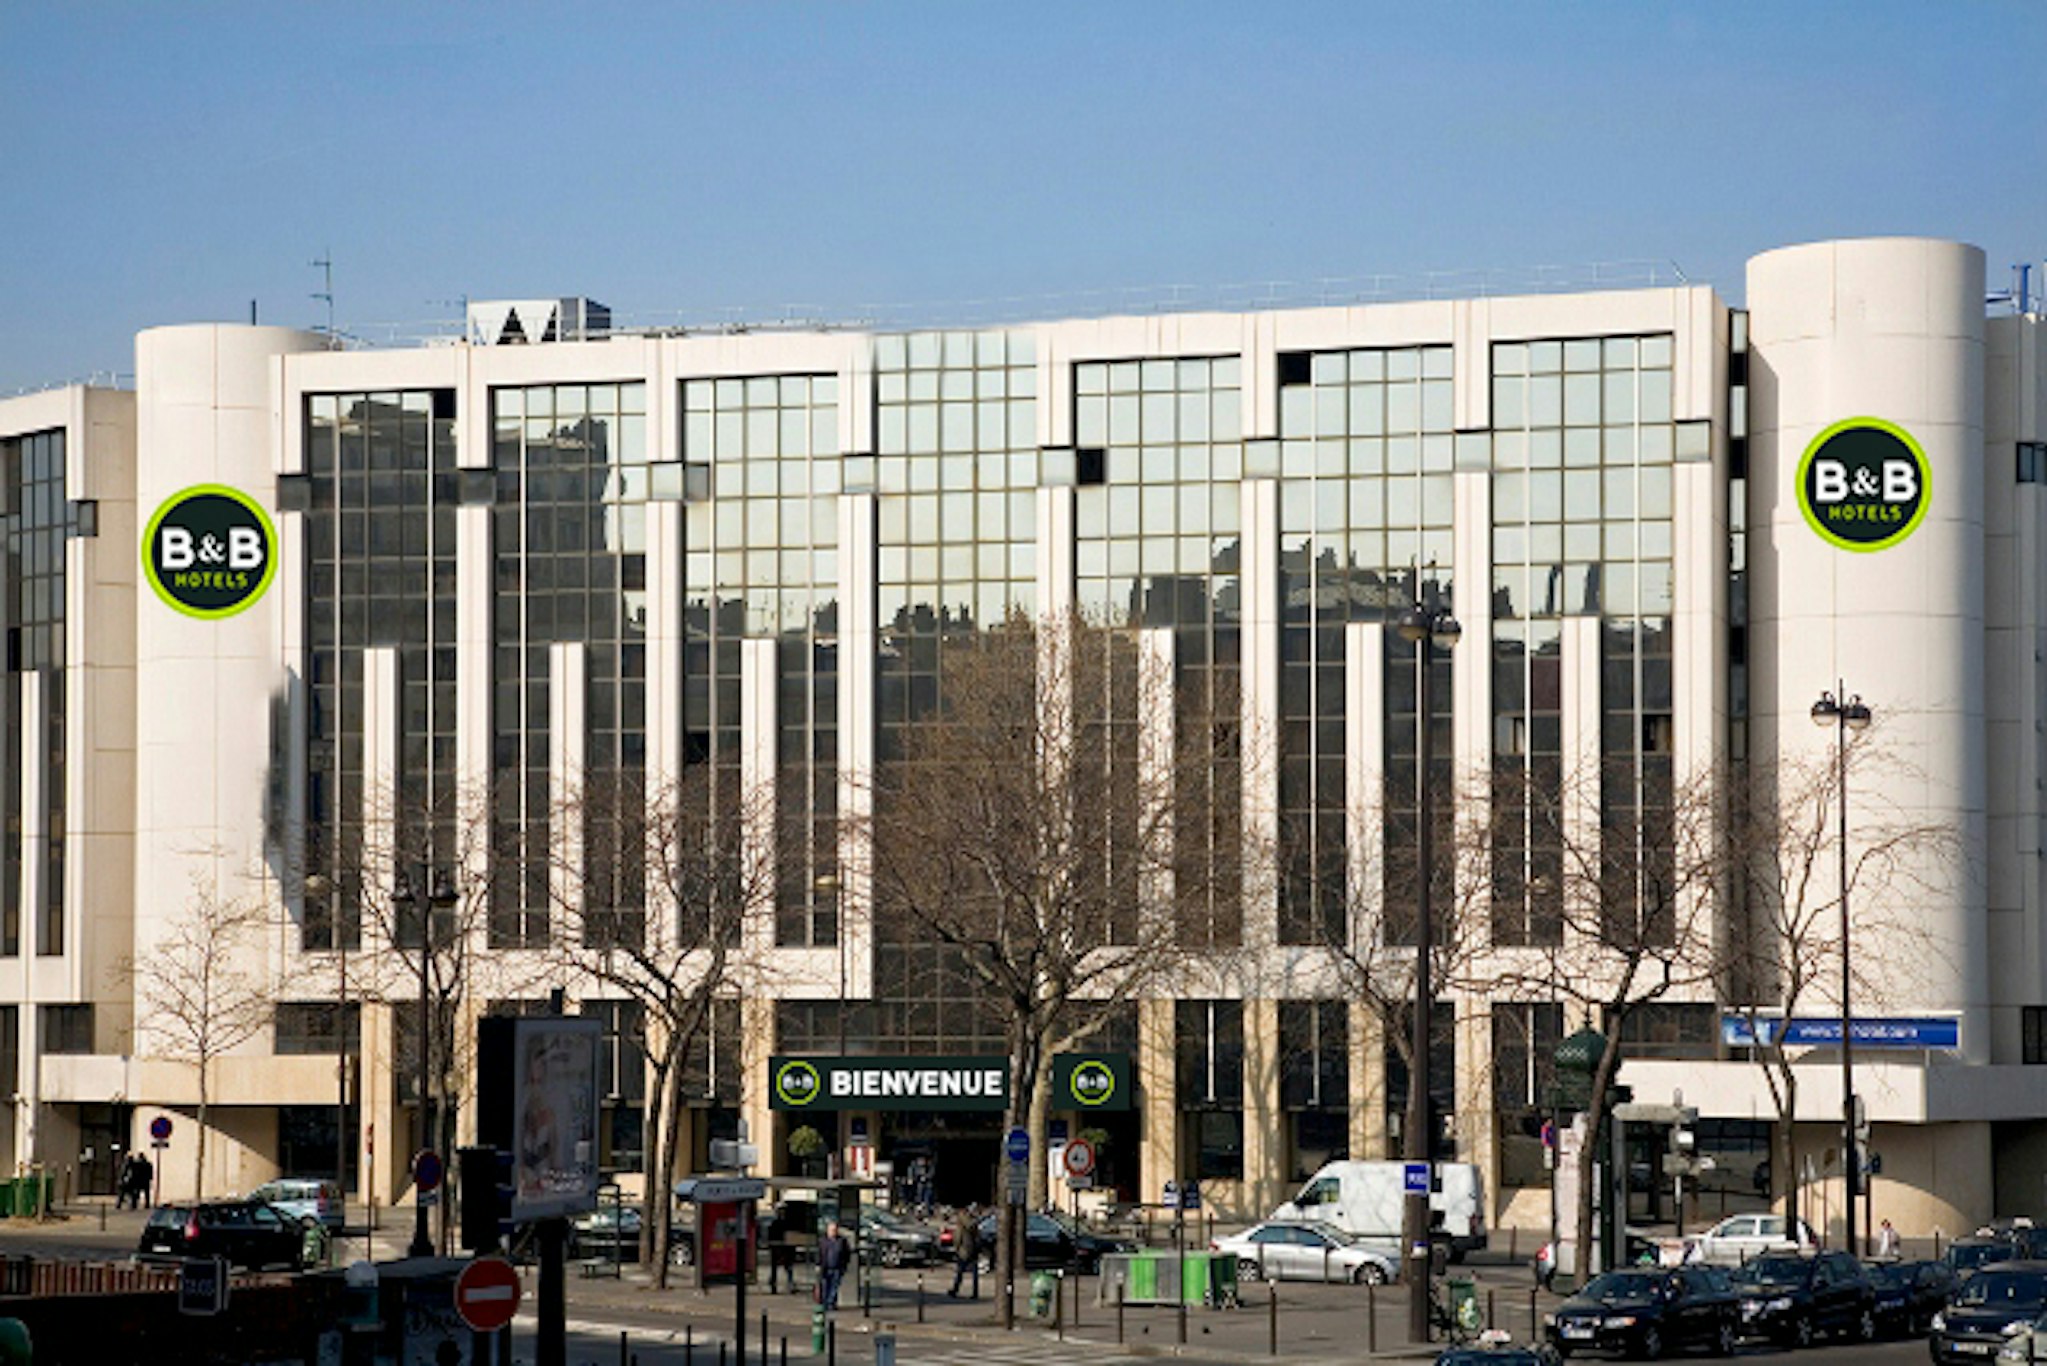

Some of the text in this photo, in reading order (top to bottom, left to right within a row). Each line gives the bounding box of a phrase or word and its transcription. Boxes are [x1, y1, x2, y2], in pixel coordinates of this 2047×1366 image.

[1816, 460, 1917, 501] B&B
[1828, 504, 1902, 521] HOTELS
[162, 527, 264, 568] B&B
[174, 571, 248, 588] HOTELS
[830, 1070, 1003, 1096] BIENVENUE
